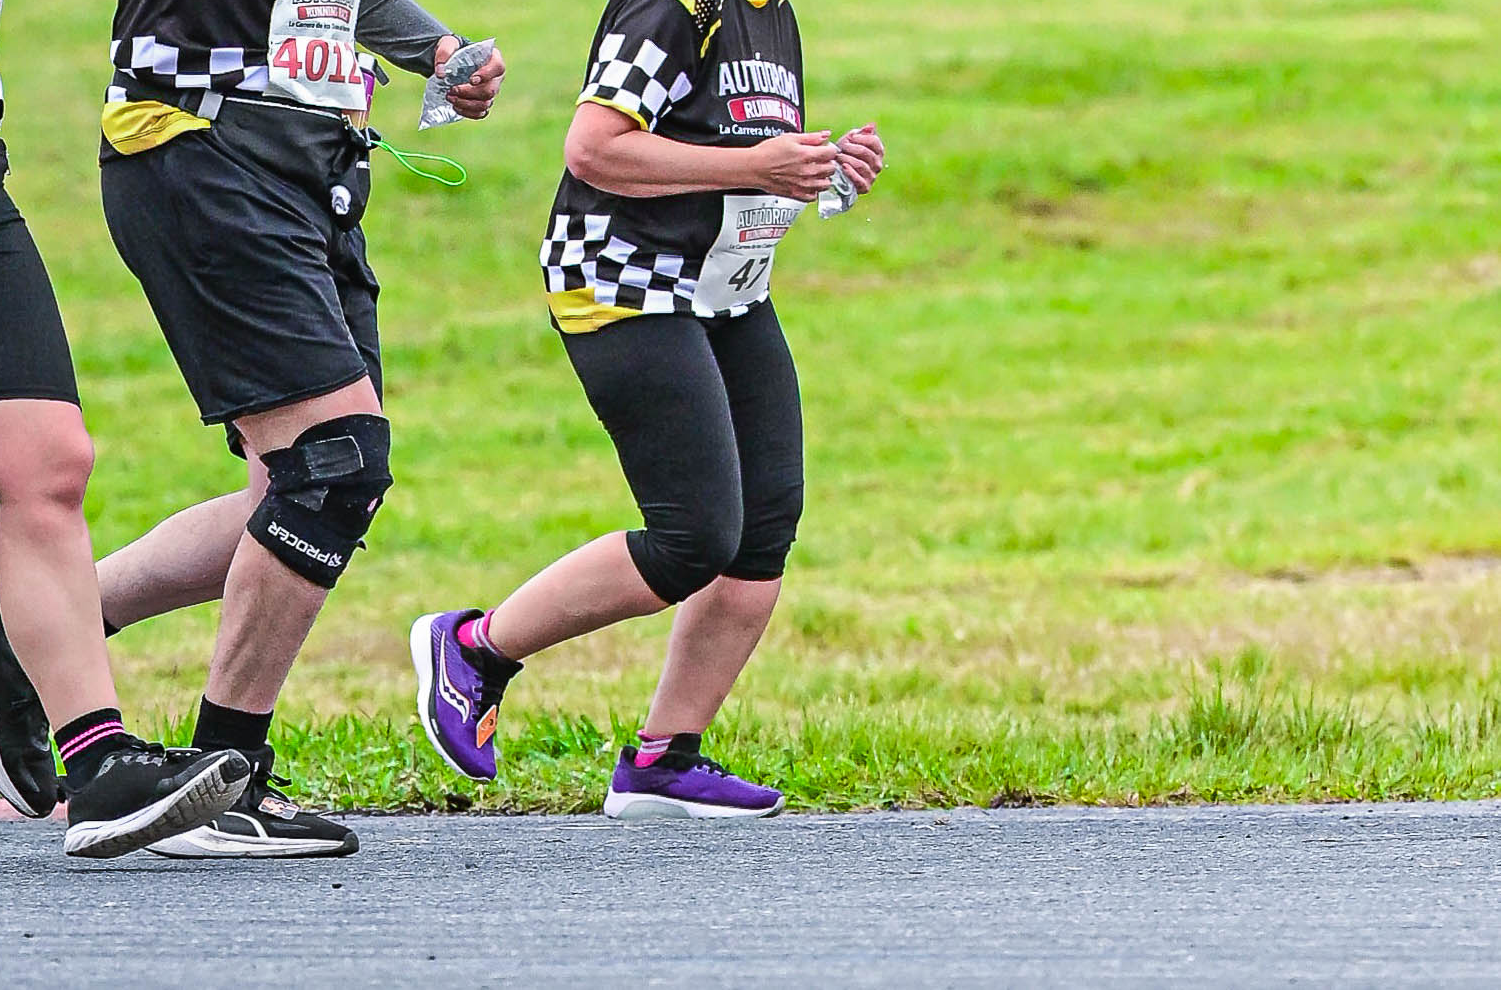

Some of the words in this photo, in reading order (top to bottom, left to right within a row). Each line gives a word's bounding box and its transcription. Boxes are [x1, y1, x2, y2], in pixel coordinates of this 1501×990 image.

[273, 38, 362, 85] 4012
[719, 124, 730, 135] La
[732, 124, 763, 136] Carrera
[728, 256, 770, 292] 47
[268, 521, 331, 564] PROCER
